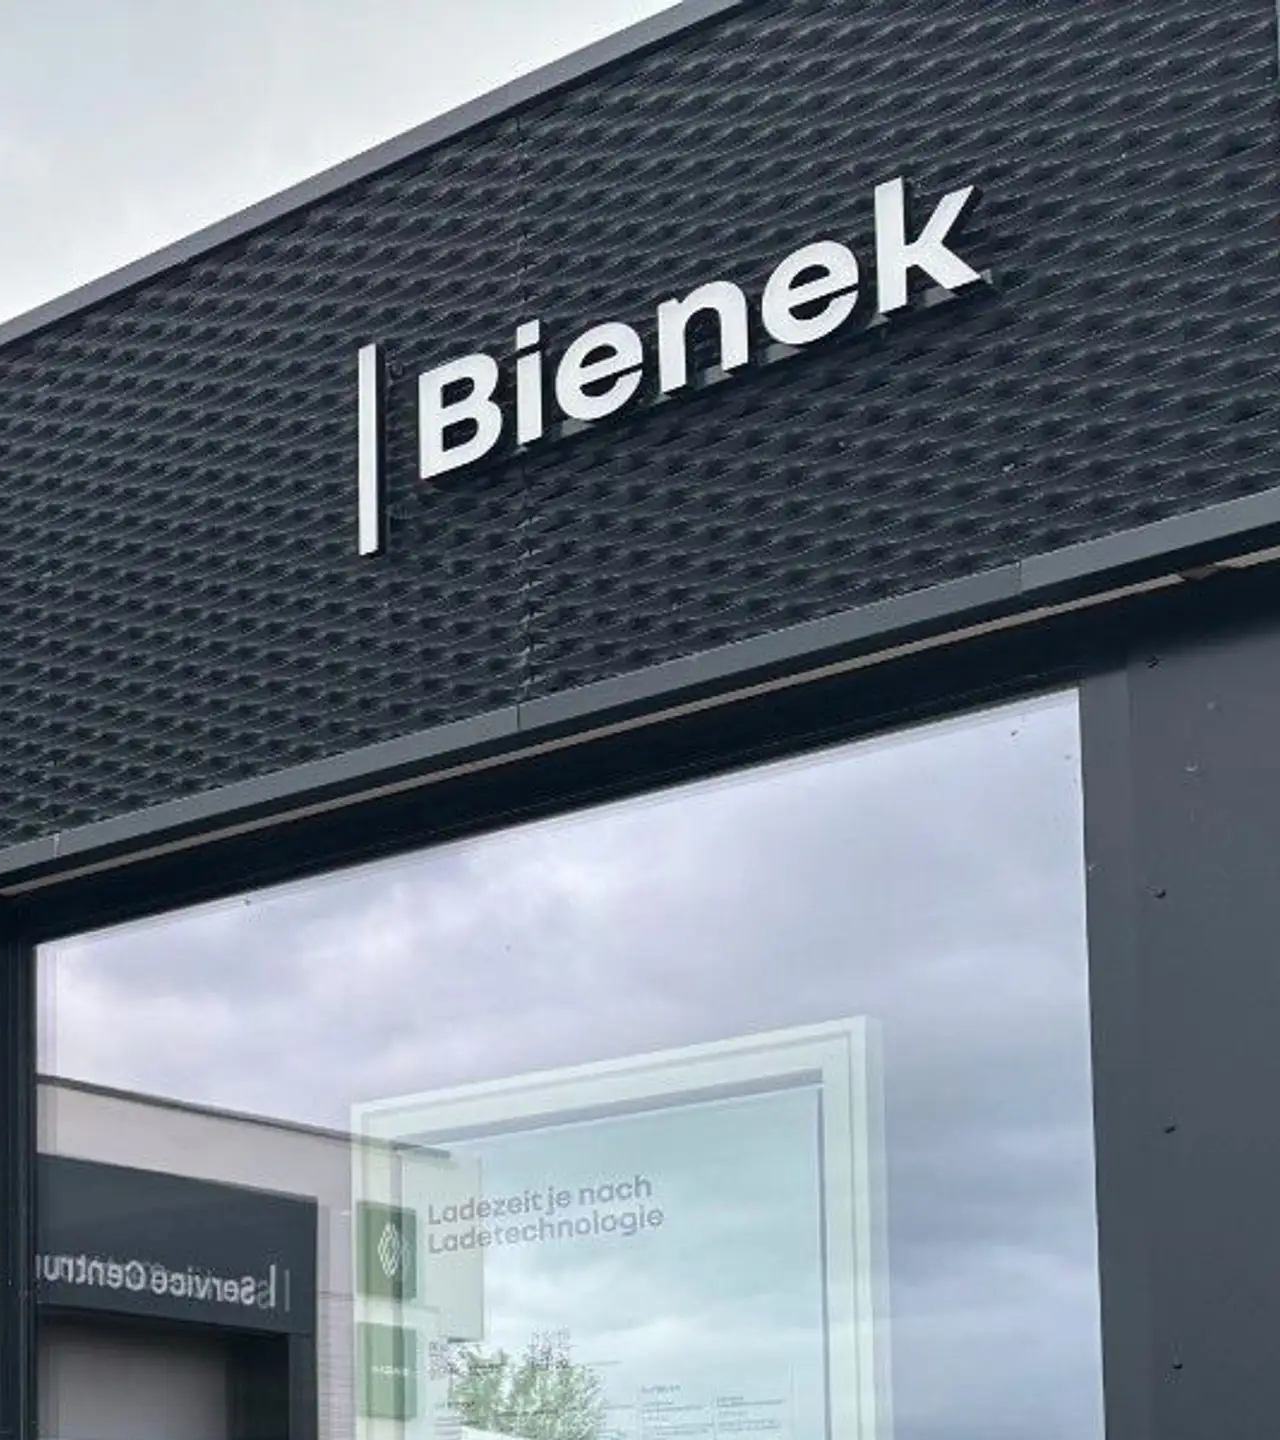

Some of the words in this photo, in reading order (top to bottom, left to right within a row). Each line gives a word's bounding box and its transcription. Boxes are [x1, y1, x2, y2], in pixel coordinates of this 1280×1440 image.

[419, 177, 982, 480] Bienek
[427, 1189, 542, 1225] Ladezeit
[545, 1184, 572, 1216] je
[578, 1174, 653, 1206] nach
[428, 1206, 665, 1254] Ladetechnologie
